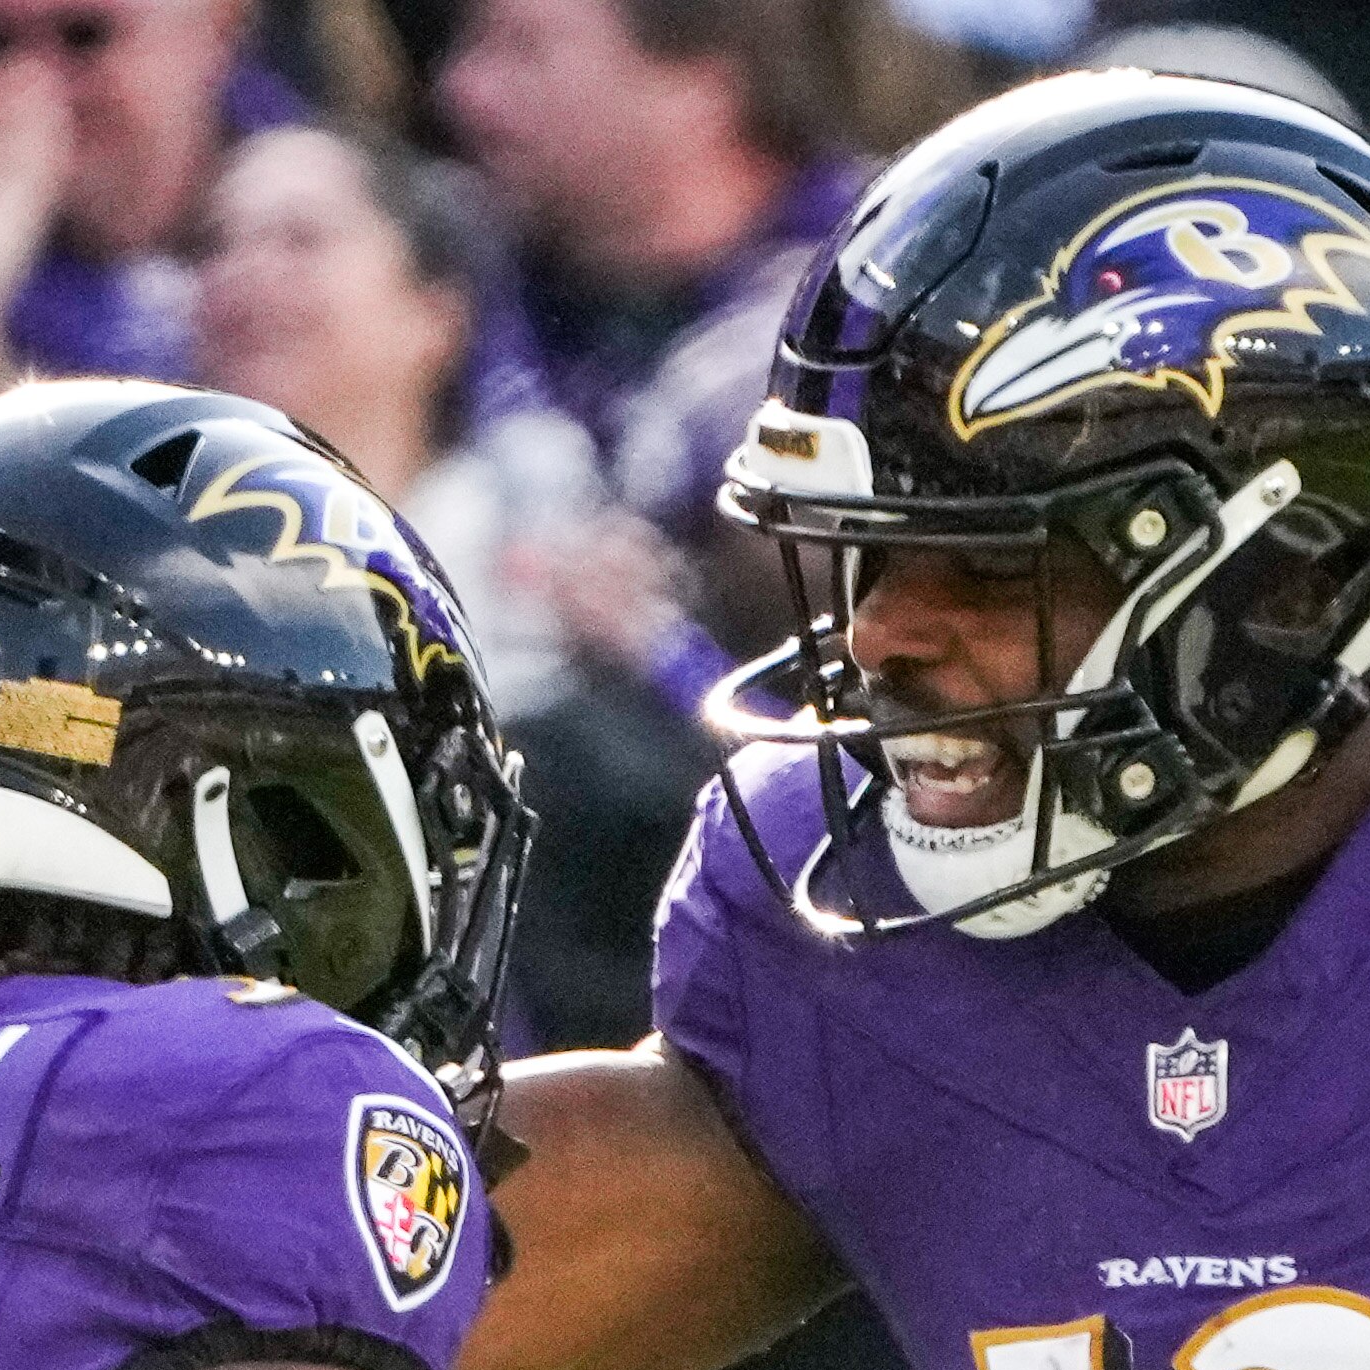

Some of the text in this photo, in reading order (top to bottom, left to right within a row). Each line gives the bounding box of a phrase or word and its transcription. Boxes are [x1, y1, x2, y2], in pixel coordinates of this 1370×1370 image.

[1095, 199, 1294, 290] B
[1160, 1078, 1212, 1121] NFL
[371, 1109, 460, 1173] RAVENS
[1098, 1255, 1299, 1289] RAVENS
